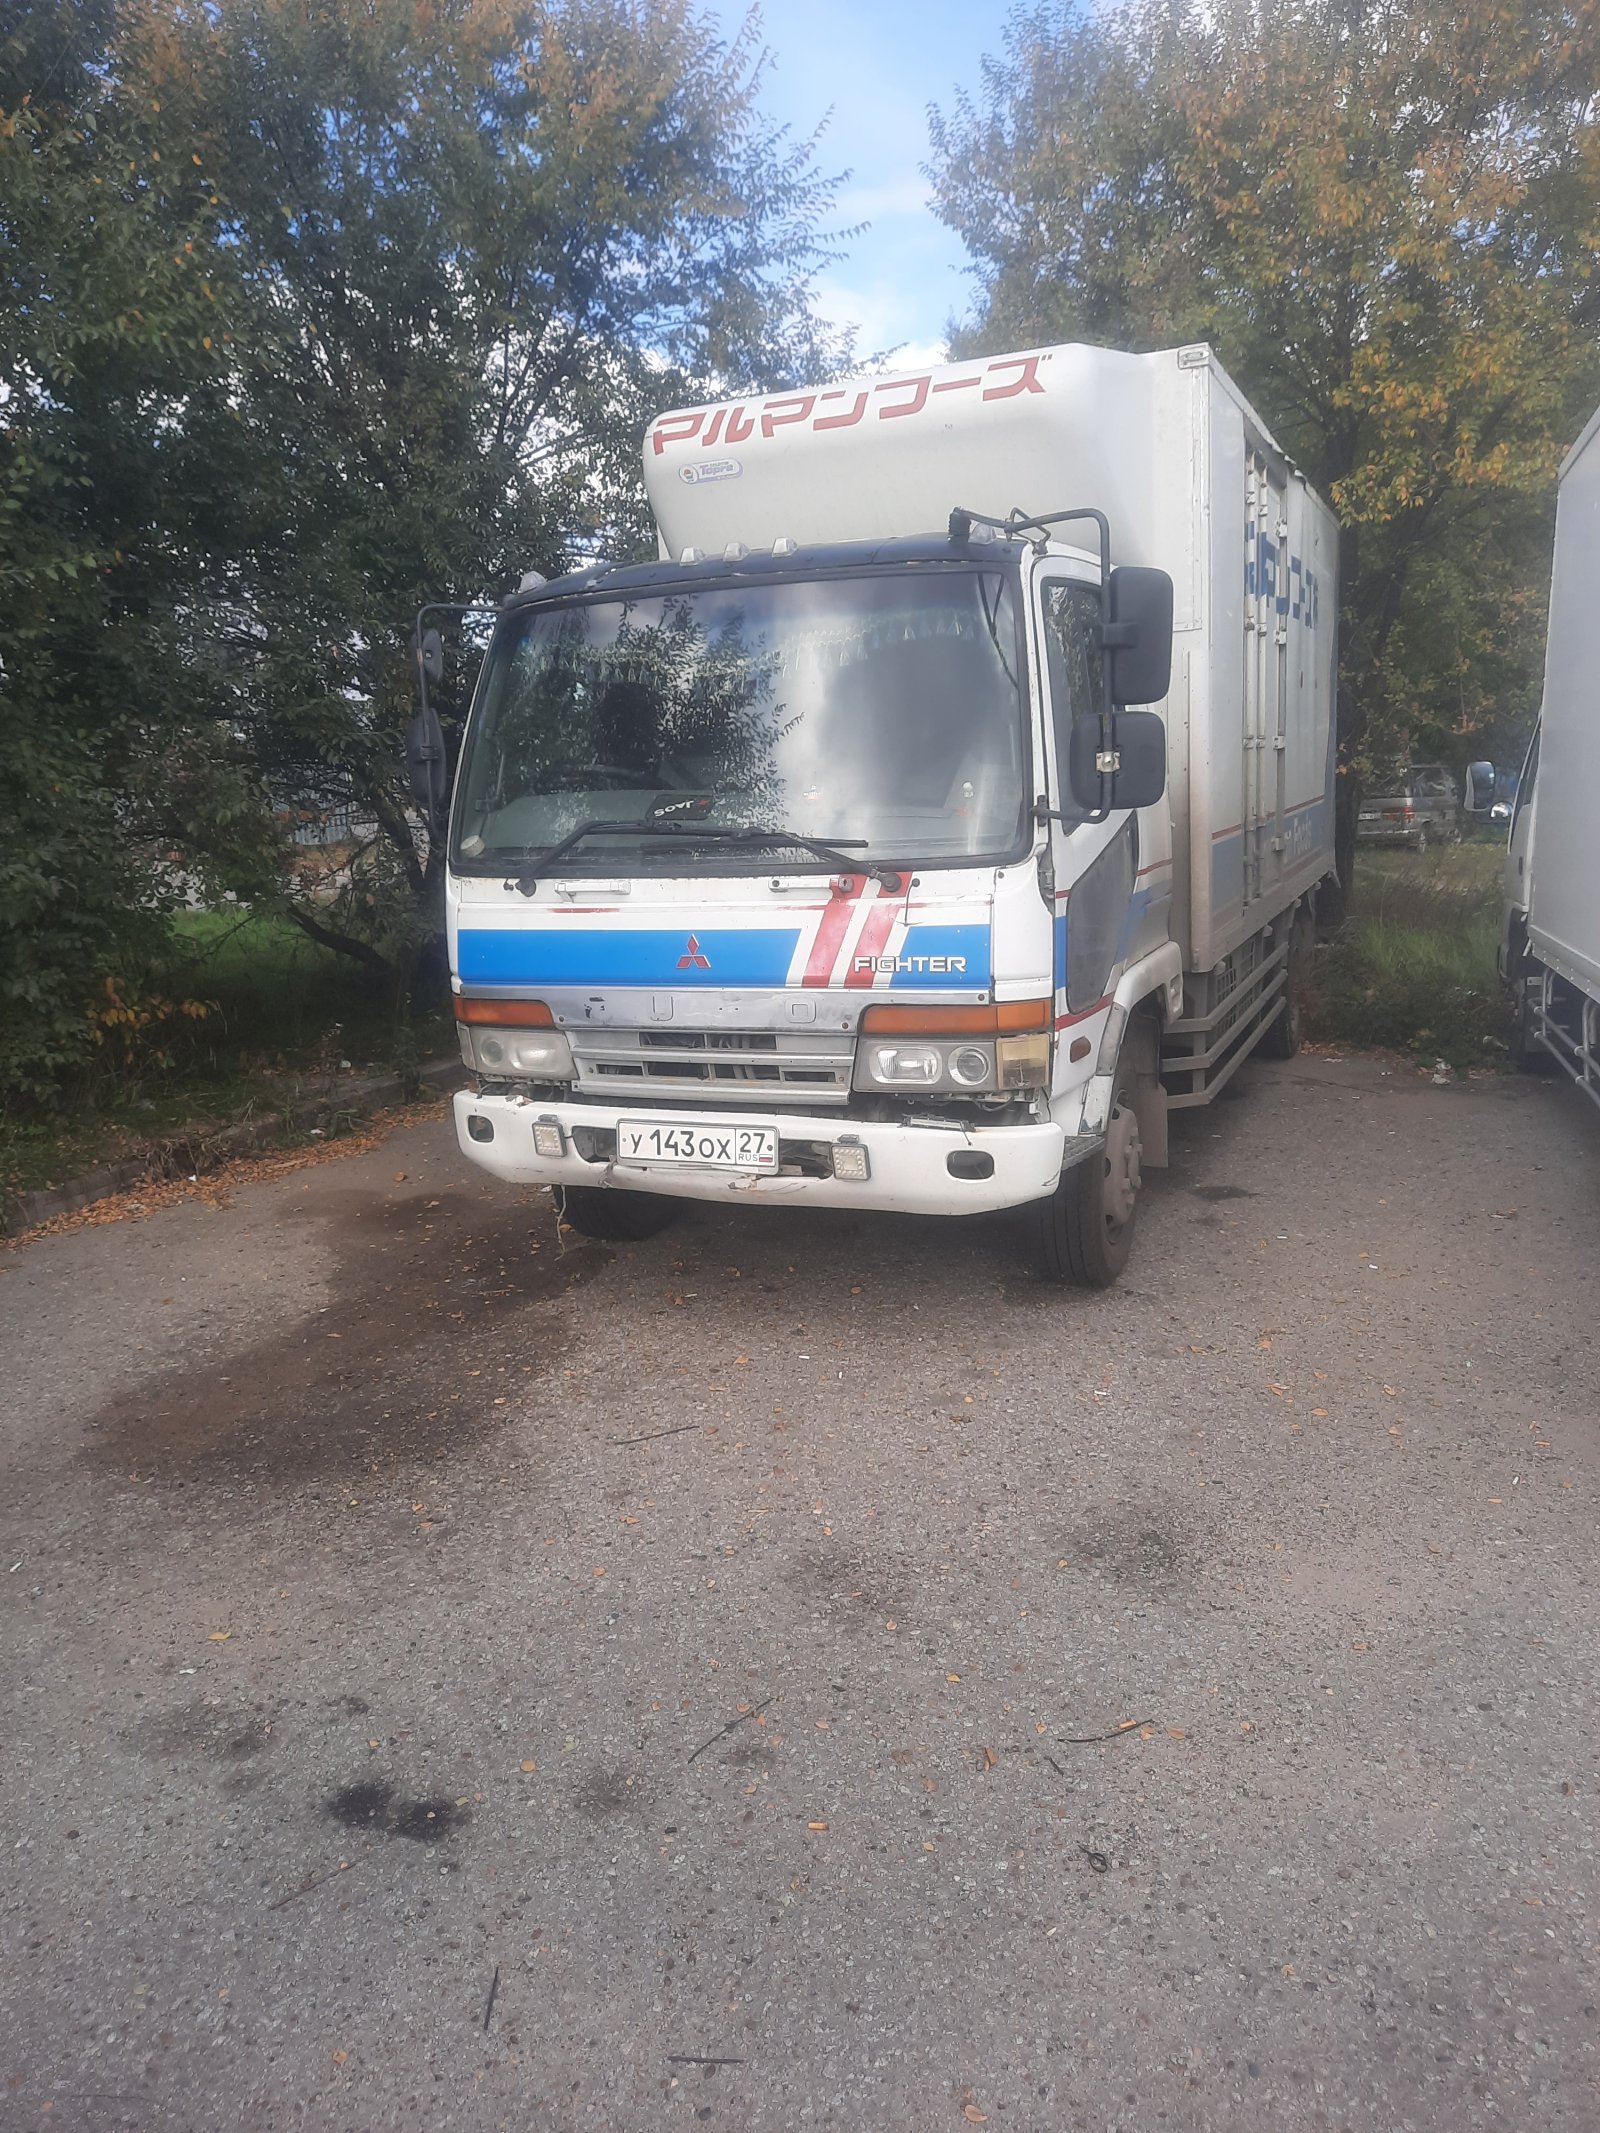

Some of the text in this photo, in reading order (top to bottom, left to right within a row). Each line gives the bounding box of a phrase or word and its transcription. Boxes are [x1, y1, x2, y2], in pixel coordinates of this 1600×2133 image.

[652, 353, 1053, 456] マルマンフーズ
[854, 956, 967, 973] FIGHTER
[739, 1132, 766, 1154] 27
[738, 1153, 758, 1162] RUS
